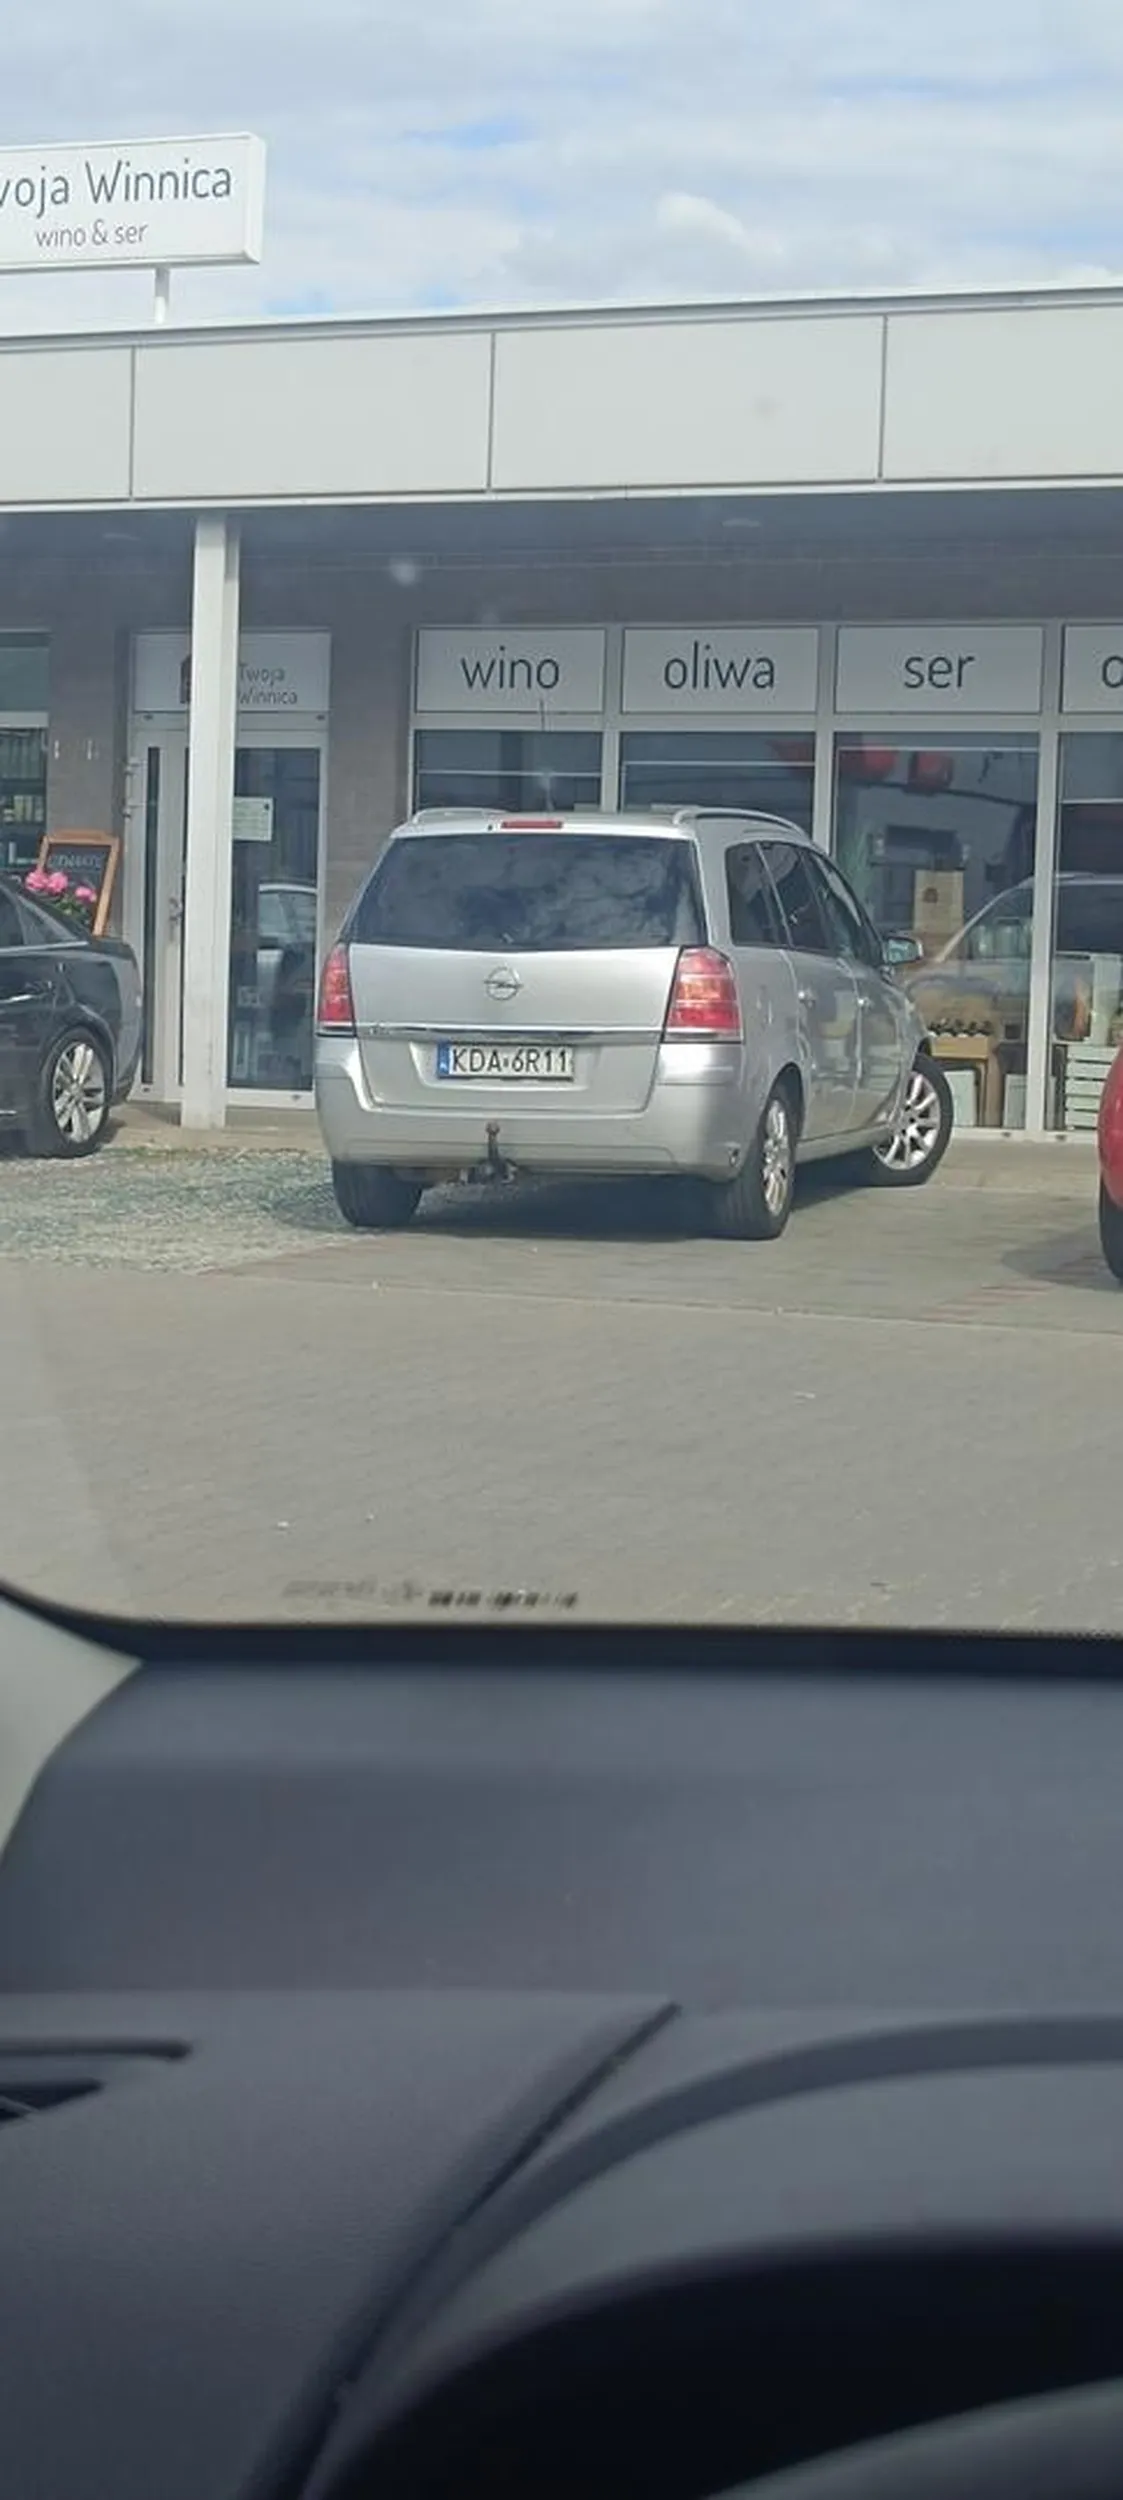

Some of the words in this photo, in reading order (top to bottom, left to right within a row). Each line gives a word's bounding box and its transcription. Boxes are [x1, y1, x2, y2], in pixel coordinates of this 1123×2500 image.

[85, 157, 232, 205] Winnica
[35, 223, 87, 247] wino
[91, 218, 109, 246] &
[114, 222, 149, 244] ser
[460, 645, 561, 690] wino
[663, 640, 776, 690] oliwa
[904, 655, 975, 689] ser
